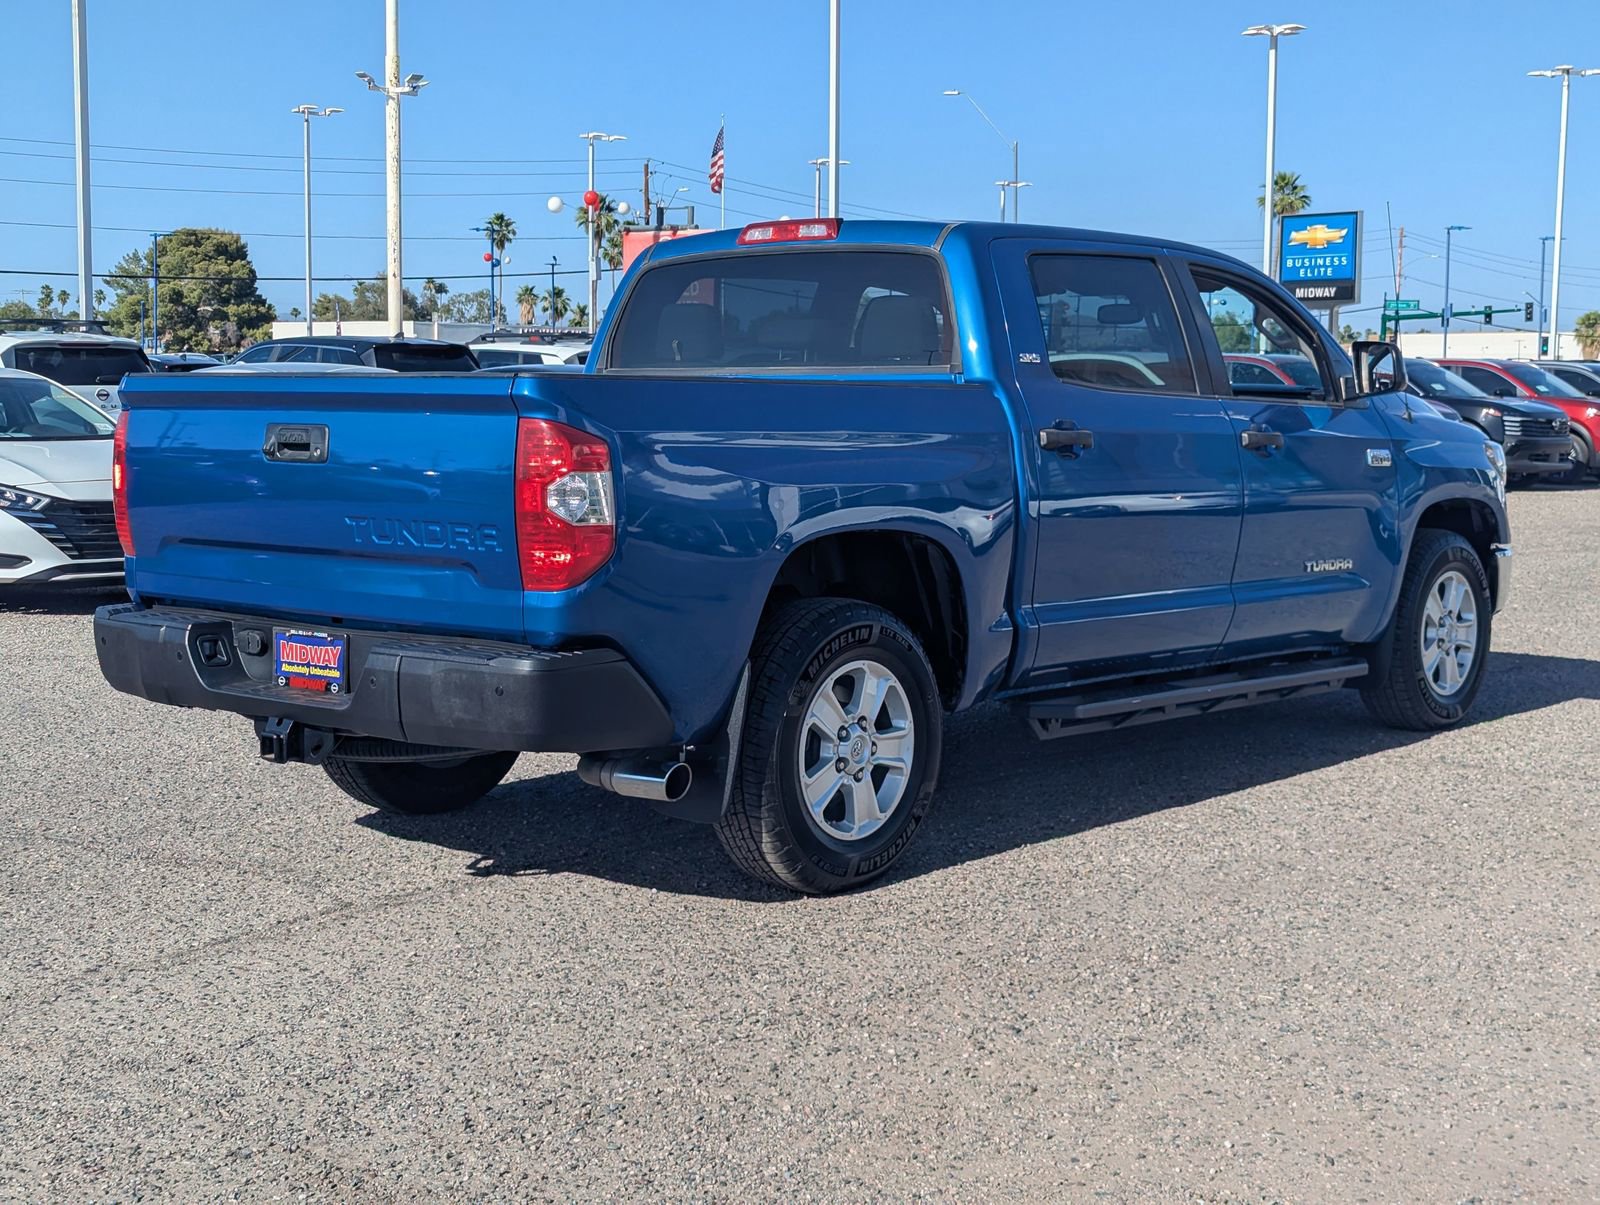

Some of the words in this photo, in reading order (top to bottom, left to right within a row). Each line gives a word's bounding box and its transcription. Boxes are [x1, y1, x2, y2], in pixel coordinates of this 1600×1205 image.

[1286, 256, 1348, 268] BUSINESS
[1299, 267, 1333, 277] ELITE
[1295, 286, 1337, 299] MIDWAY
[344, 515, 503, 553] TUNDRA
[1304, 559, 1352, 572] TUNDRA
[281, 640, 341, 667] MIDWAY
[807, 626, 871, 679] MICHELIN
[281, 663, 309, 676] Absolutely
[310, 665, 340, 678] Unbeatable
